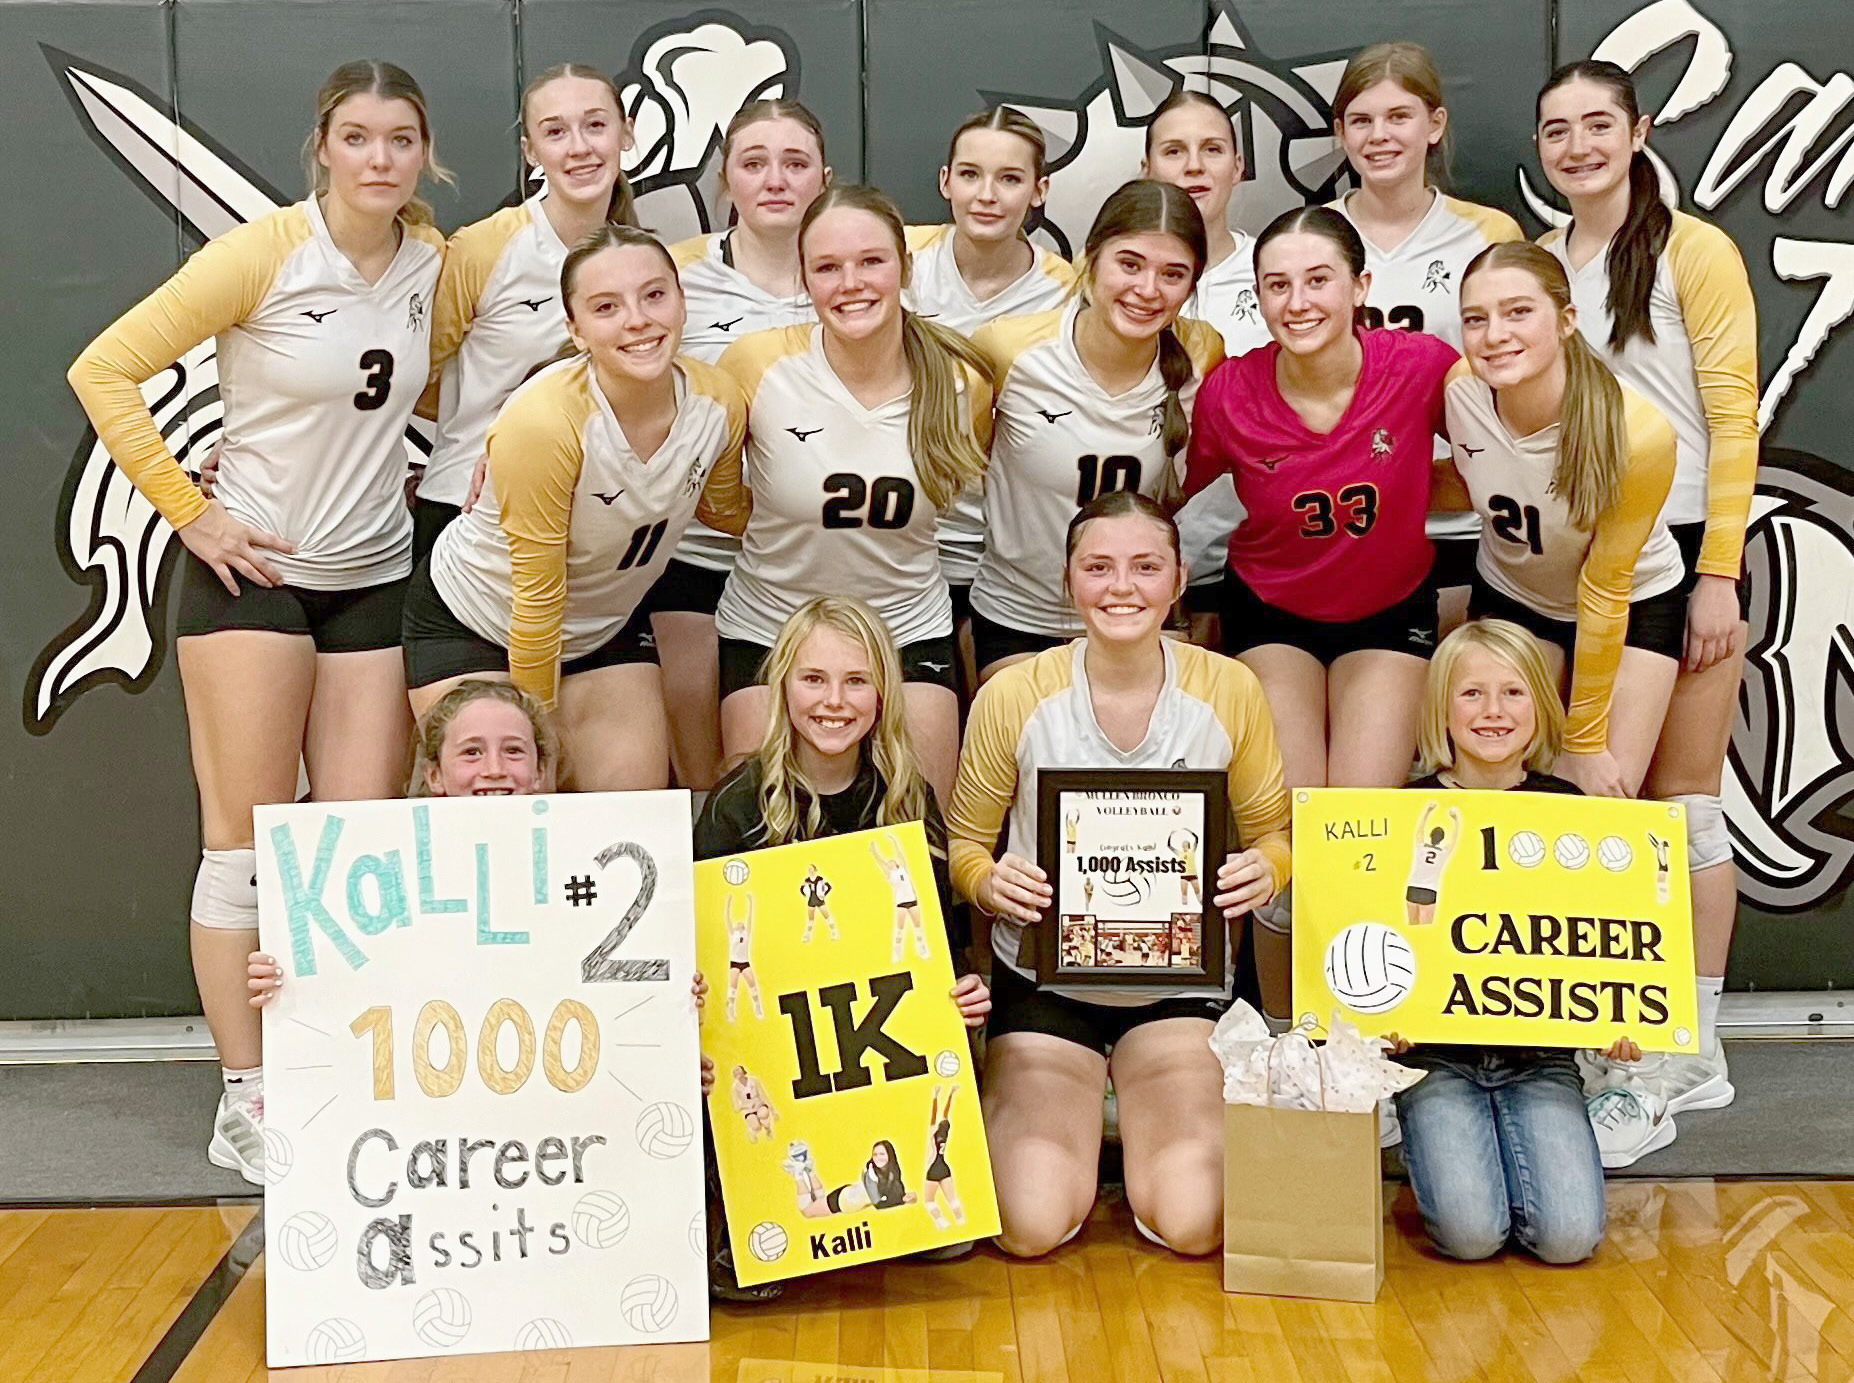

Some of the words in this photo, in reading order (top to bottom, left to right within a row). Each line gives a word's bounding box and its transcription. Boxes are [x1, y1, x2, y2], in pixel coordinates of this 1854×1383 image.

[353, 348, 394, 411] 3
[822, 473, 915, 530] 20
[1077, 453, 1142, 508] 10
[1291, 482, 1379, 539] 33
[1488, 494, 1544, 555] 21
[616, 518, 669, 571] 11
[1096, 806, 1168, 815] VOLLEYBALL
[1324, 817, 1388, 841] KALLI
[1076, 856, 1121, 875] 1,000
[1125, 856, 1187, 874] Assists
[1450, 913, 1665, 962] CAREER
[1441, 973, 1669, 1025] ASSISTS
[348, 997, 601, 1101] 1000
[778, 970, 929, 1100] 1K
[347, 1127, 608, 1208] Career
[809, 1221, 873, 1260] Kalli
